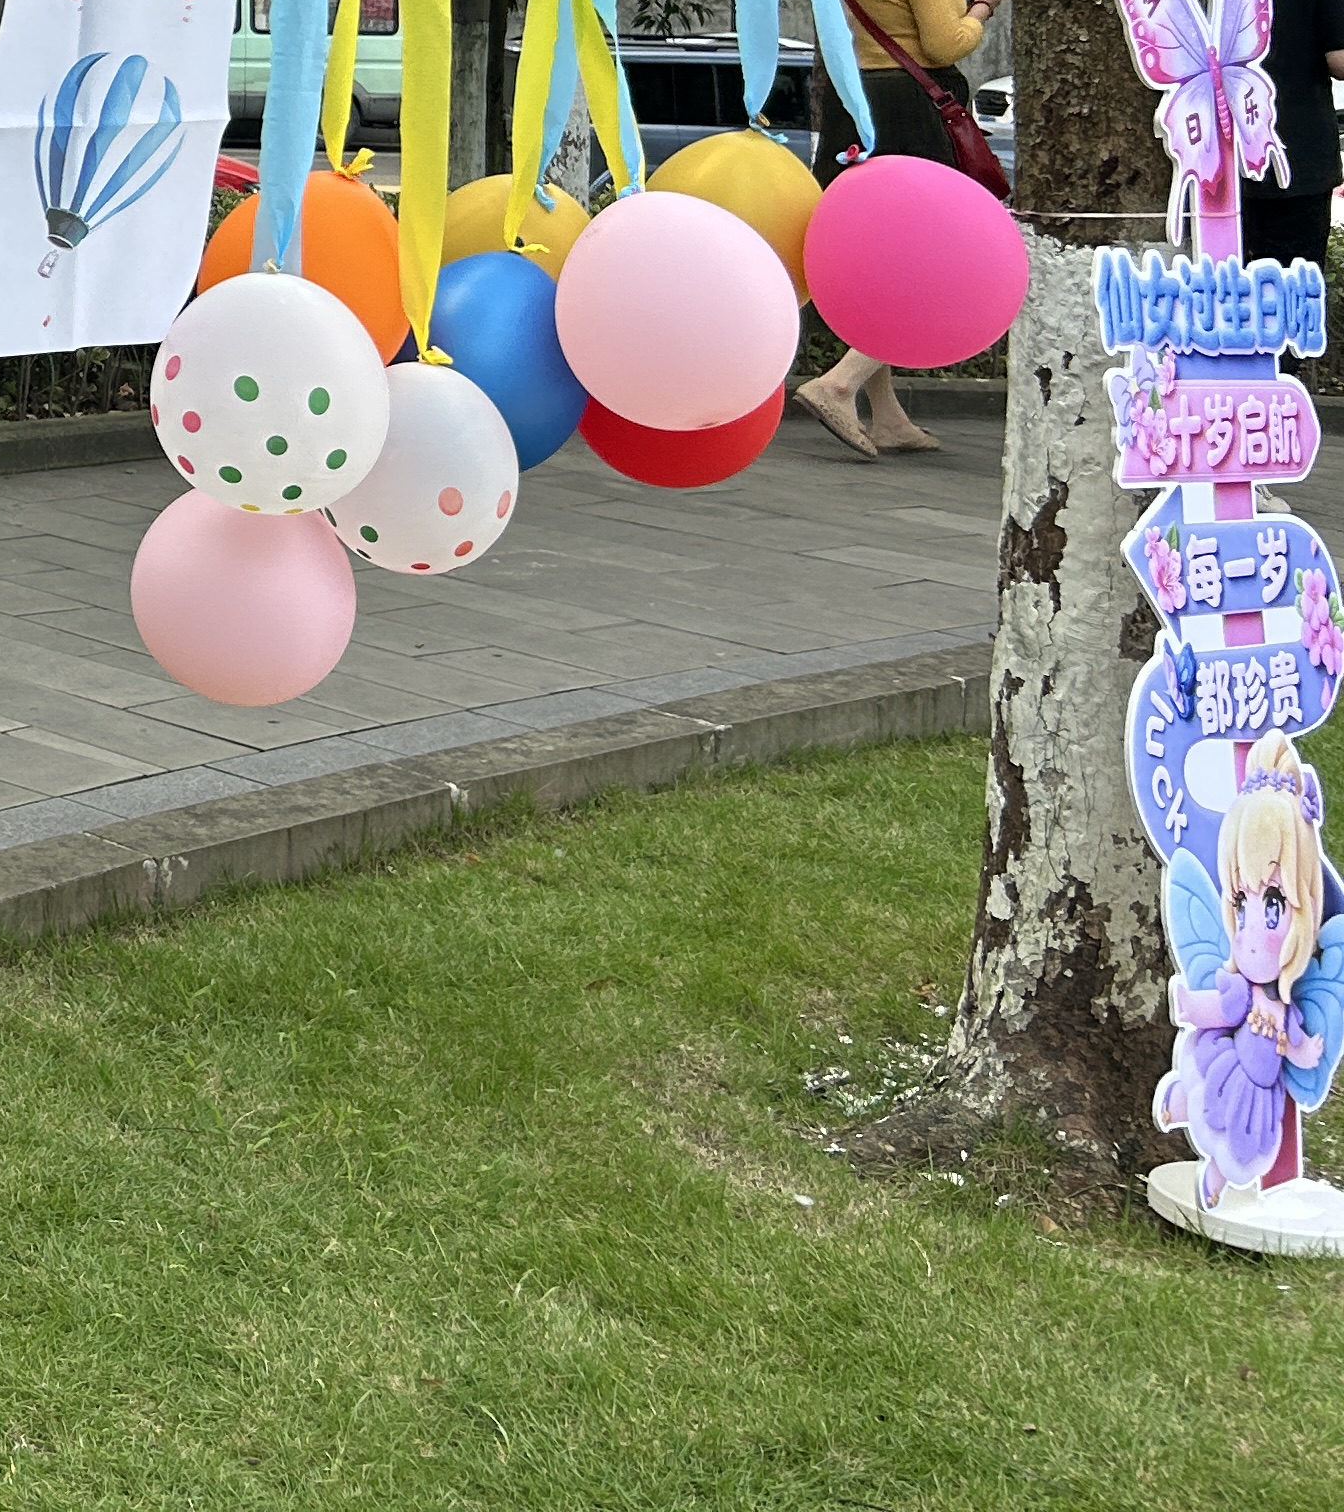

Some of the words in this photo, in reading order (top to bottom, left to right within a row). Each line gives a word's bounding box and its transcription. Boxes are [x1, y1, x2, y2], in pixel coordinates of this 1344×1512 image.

[1097, 253, 1323, 350] 仙女过生日啦
[1170, 394, 1302, 468] 十岁启航
[1186, 526, 1289, 609] 每一岁
[1195, 650, 1303, 736] 都珍贵
